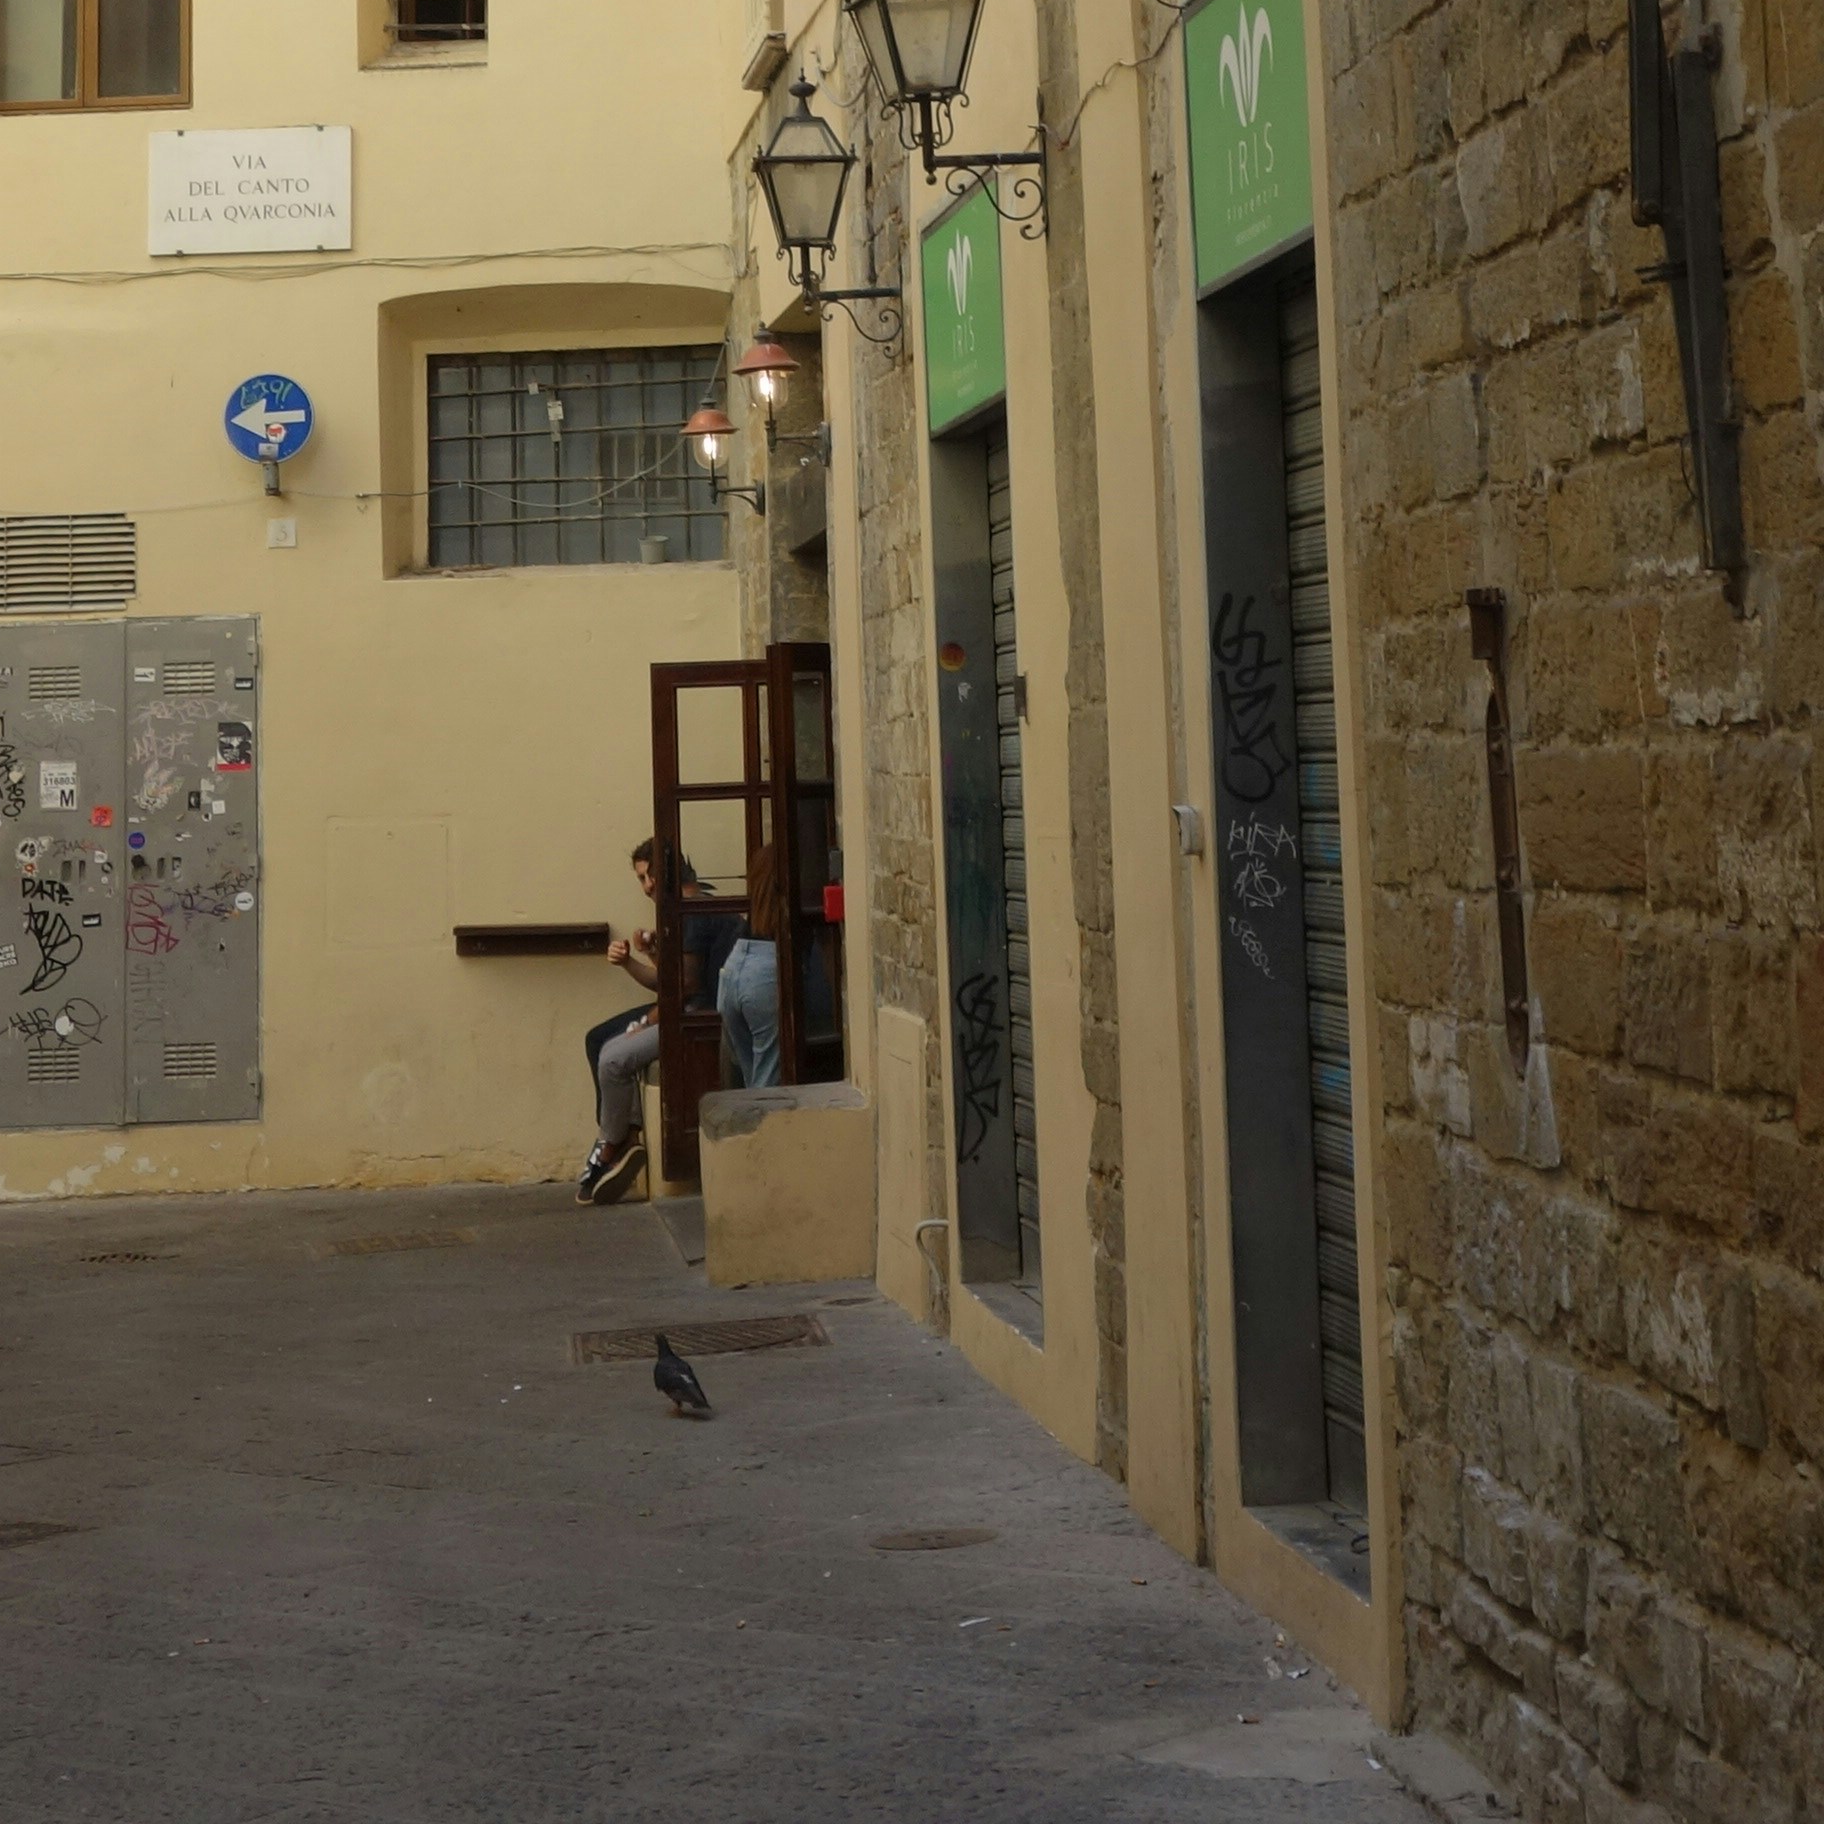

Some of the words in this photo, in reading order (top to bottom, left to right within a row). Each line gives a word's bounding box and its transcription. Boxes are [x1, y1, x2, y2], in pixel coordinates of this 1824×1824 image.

[232, 154, 267, 170] VIA
[1227, 121, 1275, 195] IRIS
[188, 180, 225, 197] DEL
[237, 177, 310, 195] CANTO
[163, 207, 213, 223] ALLA
[223, 202, 336, 223] QVARCONIA
[60, 789, 74, 807] M
